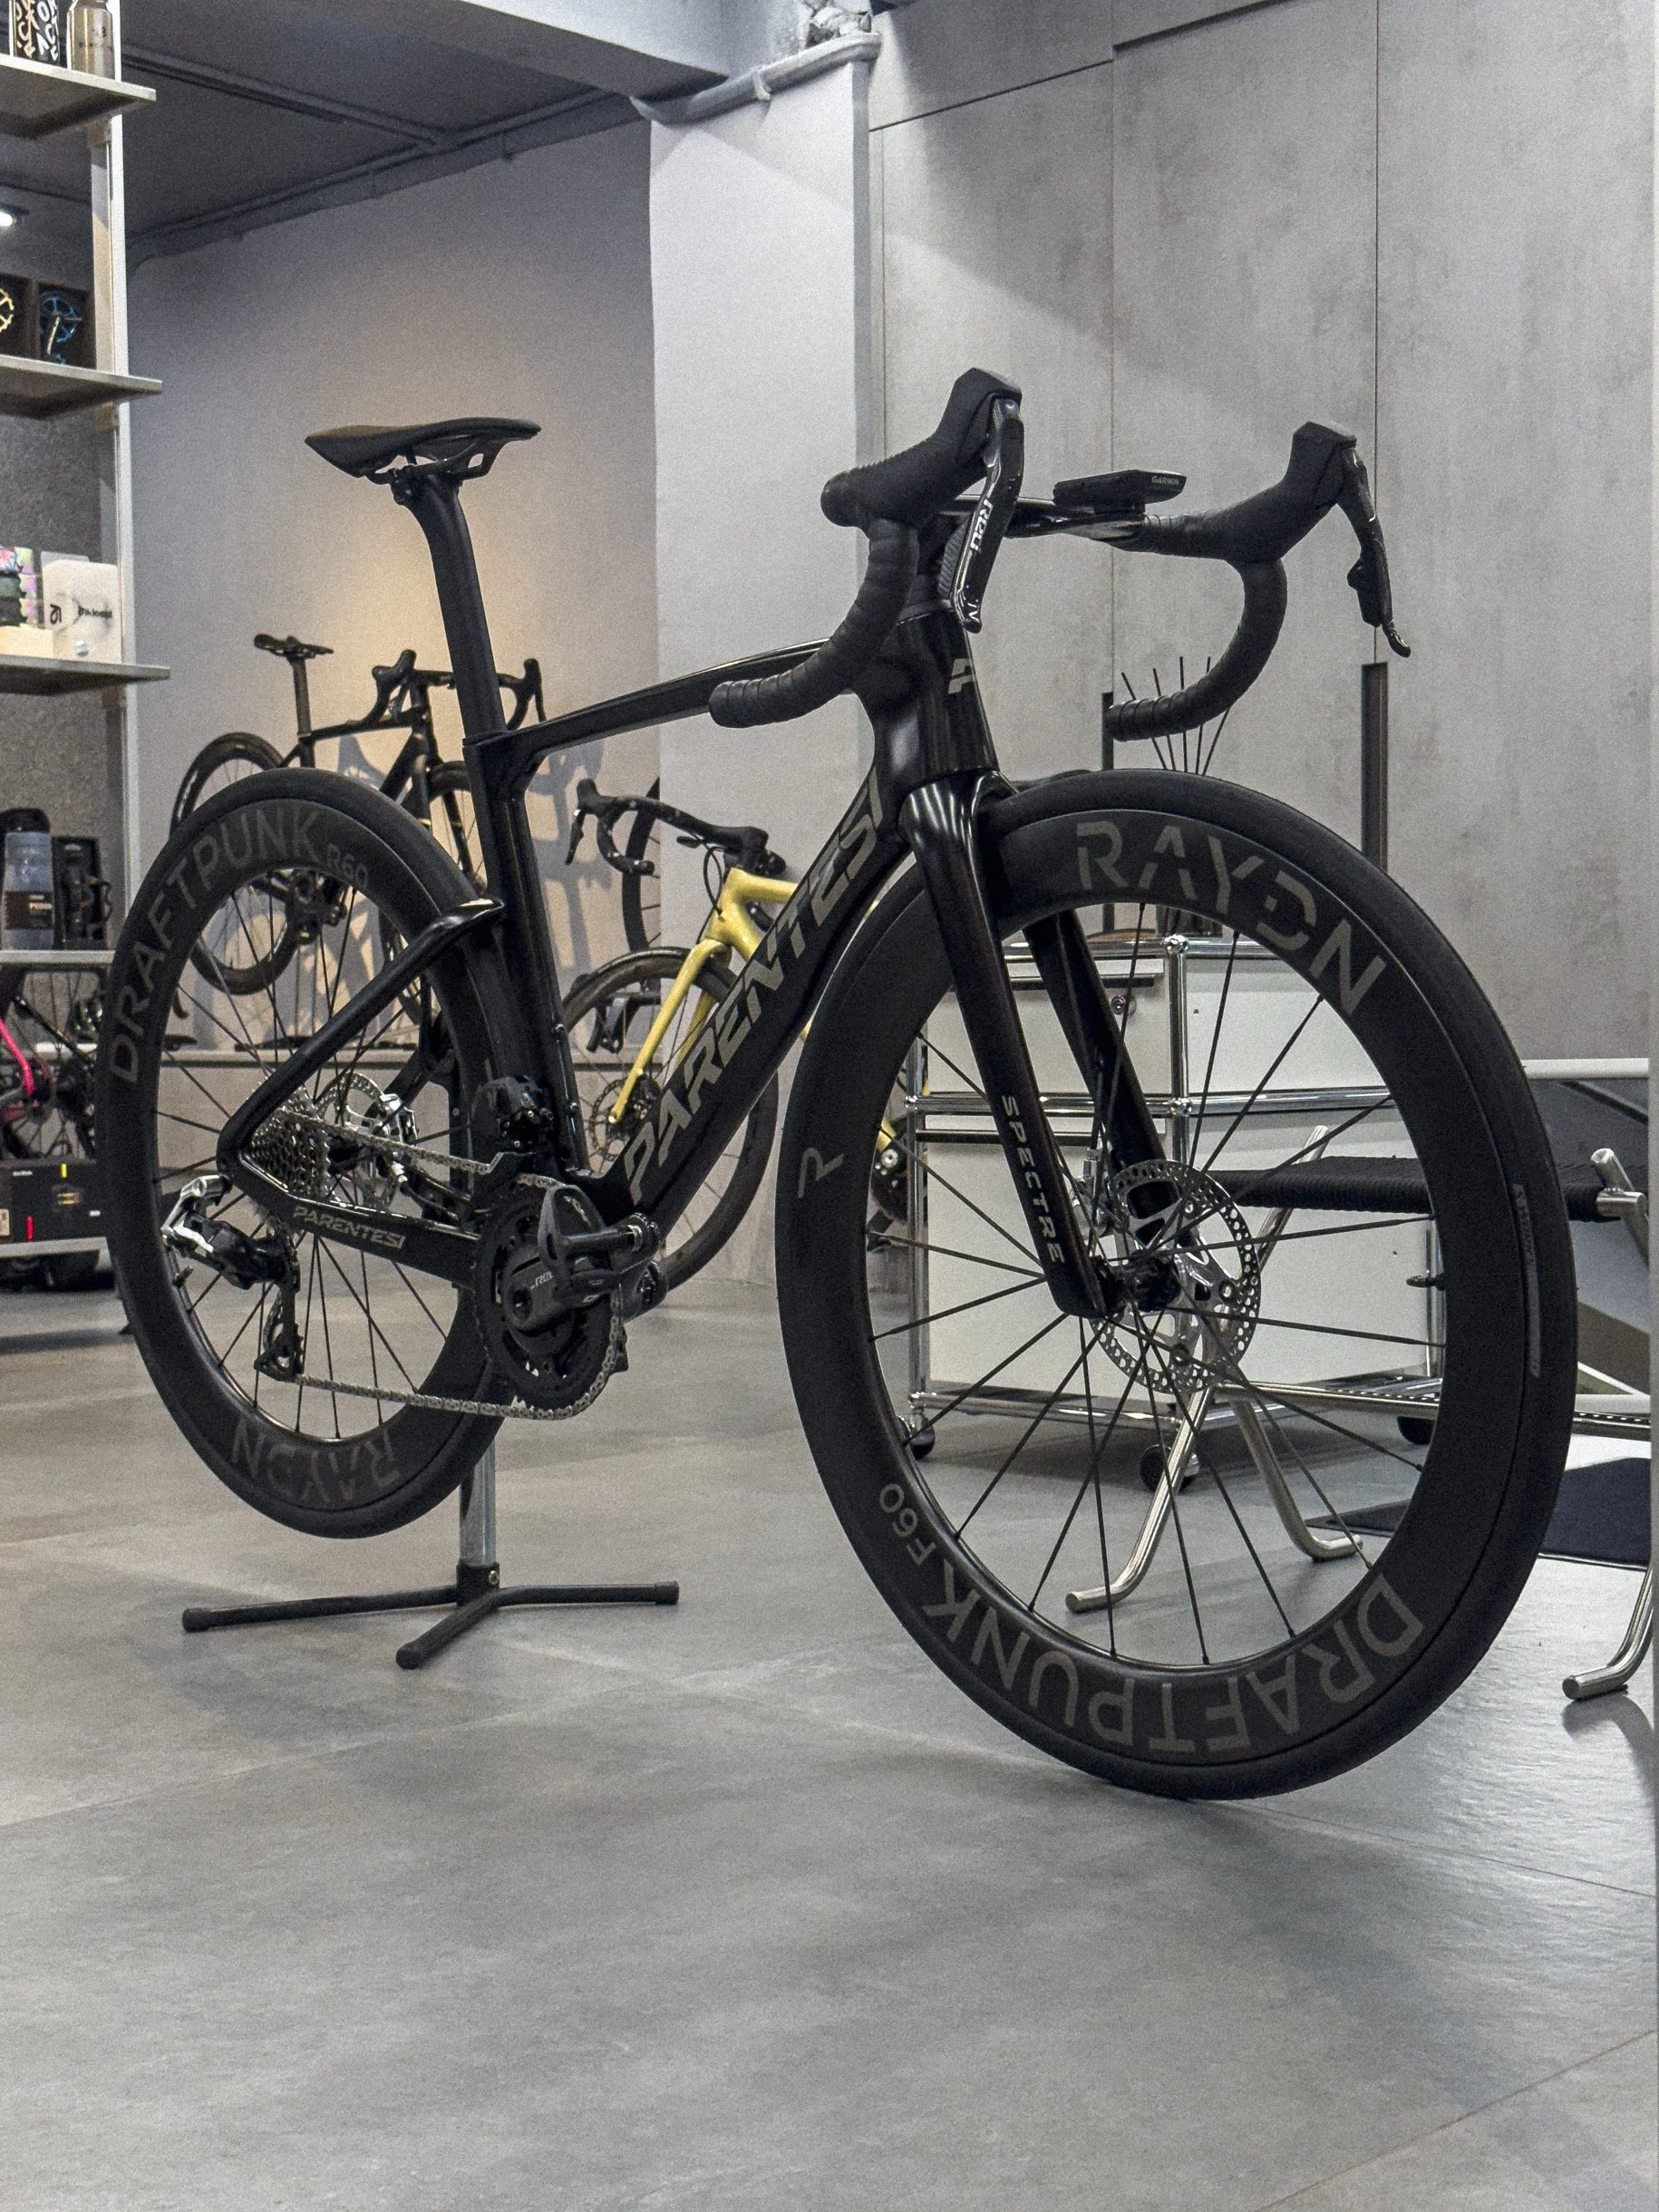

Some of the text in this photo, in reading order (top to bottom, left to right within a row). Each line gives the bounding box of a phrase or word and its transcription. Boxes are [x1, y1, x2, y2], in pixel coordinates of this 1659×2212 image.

[1151, 475, 1180, 486] GARMIN
[1002, 1094, 1064, 1264] SPECTRE
[879, 1482, 1425, 1751] DRAFTPUNK F60
